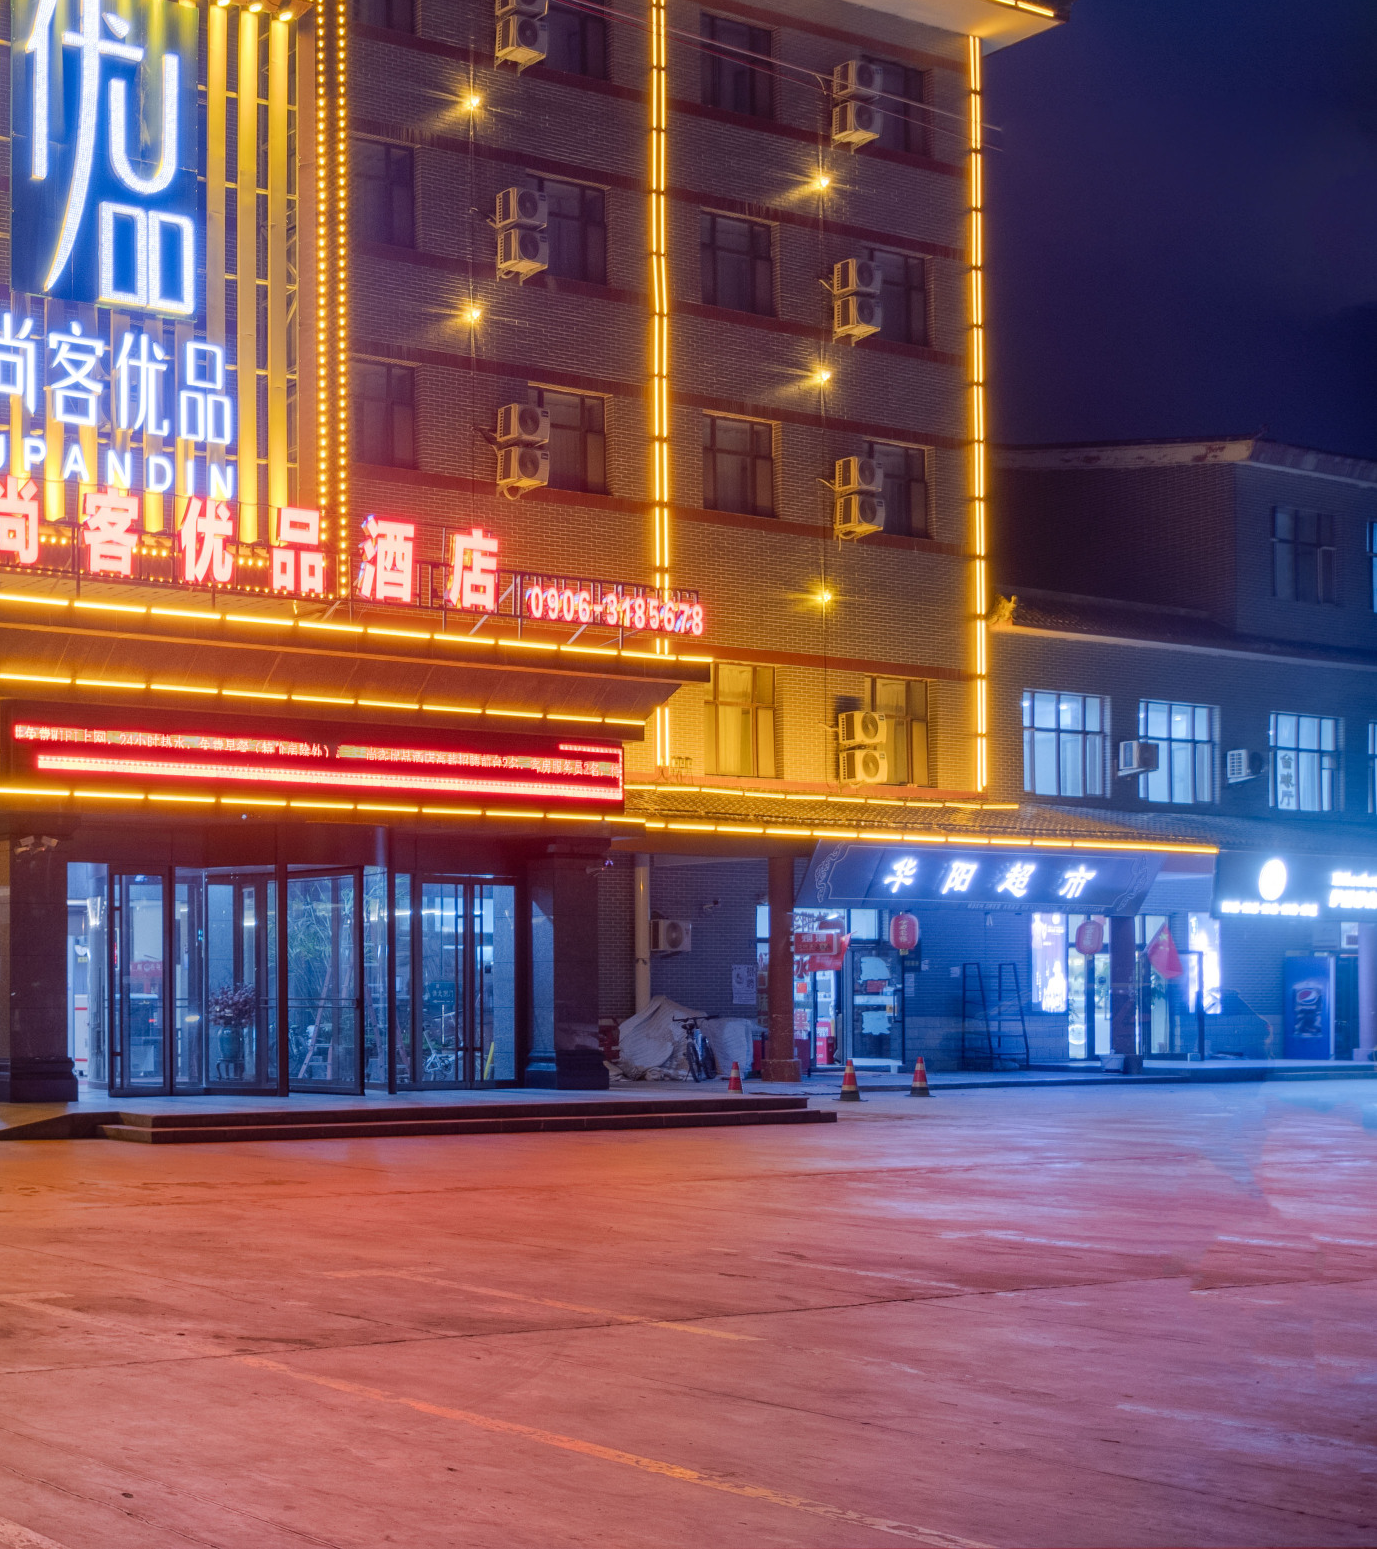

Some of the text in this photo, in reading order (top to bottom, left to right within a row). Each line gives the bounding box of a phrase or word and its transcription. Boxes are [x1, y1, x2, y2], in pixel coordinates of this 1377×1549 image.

[531, 585, 704, 636] 0906-3185678
[883, 856, 1097, 899] 华阳超市
